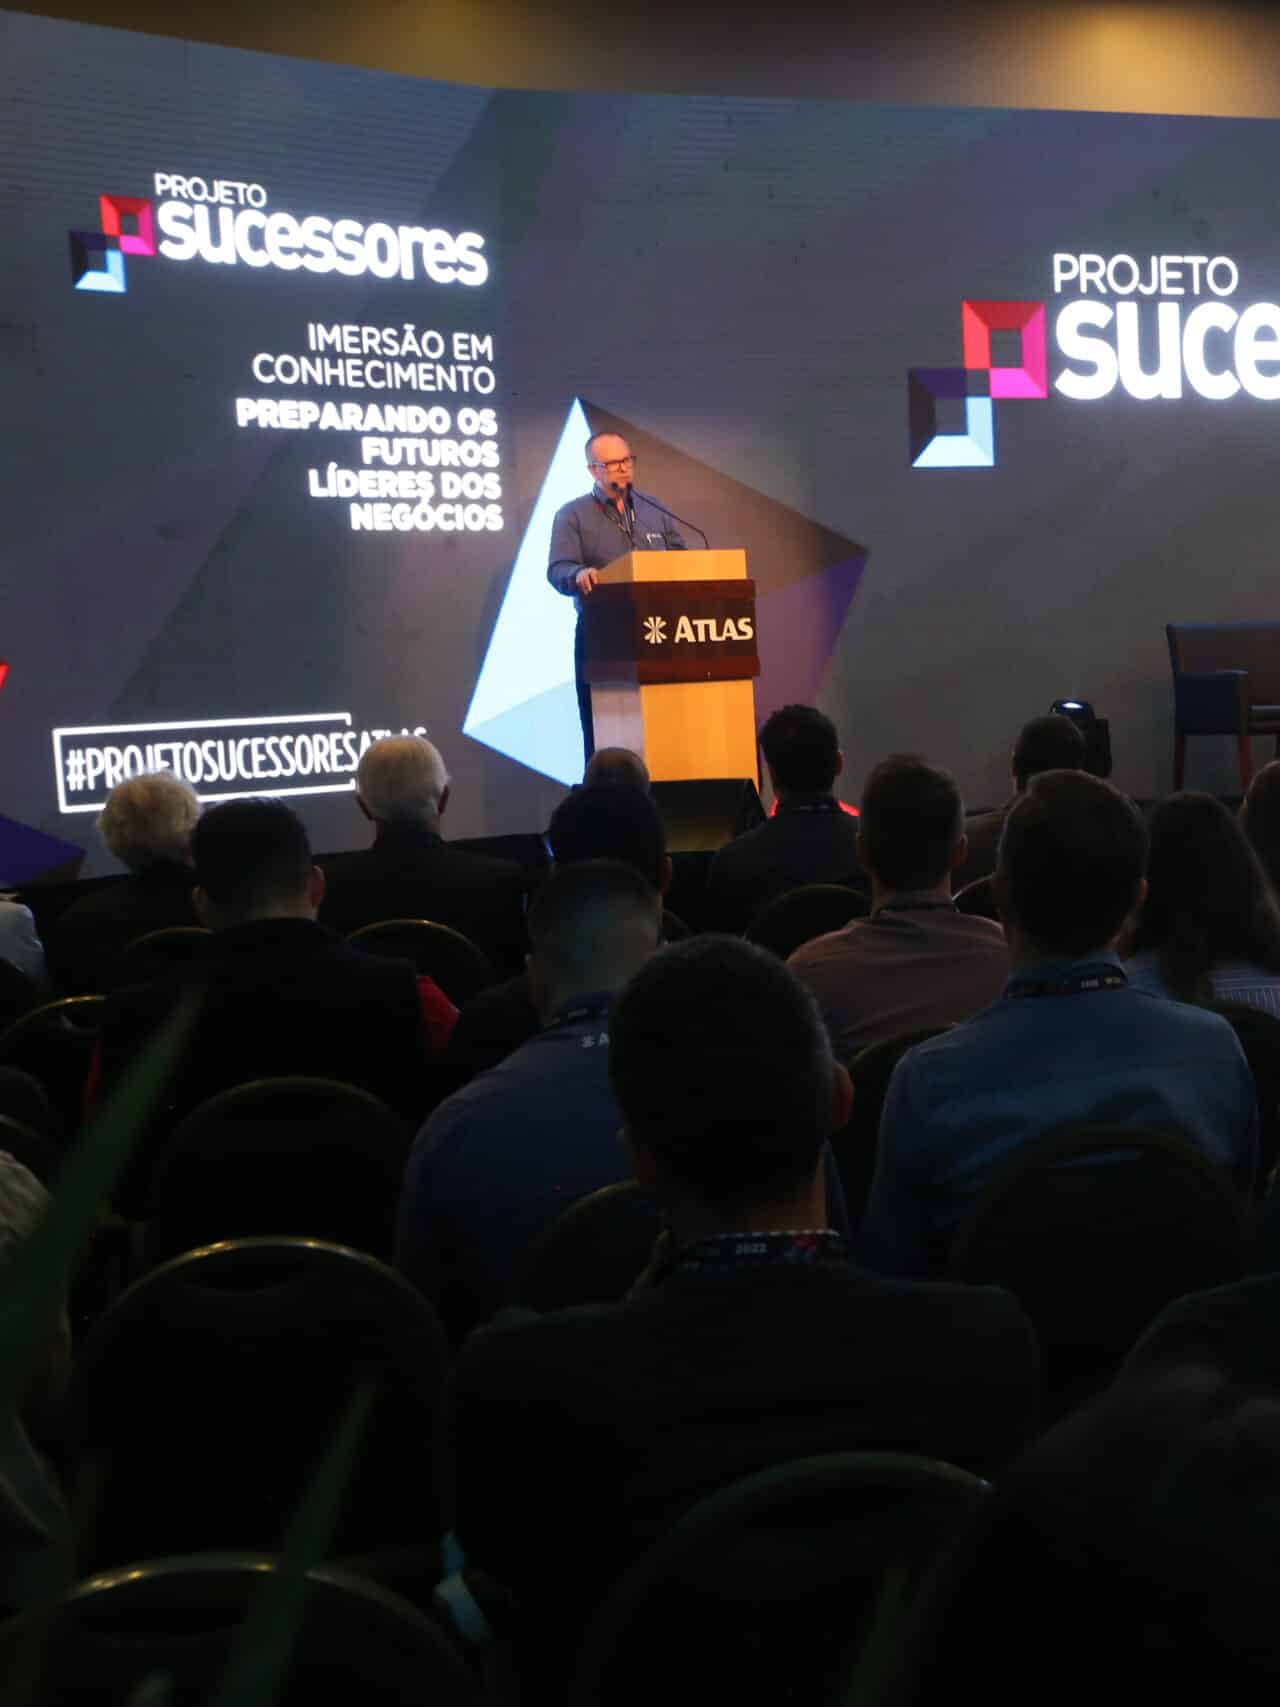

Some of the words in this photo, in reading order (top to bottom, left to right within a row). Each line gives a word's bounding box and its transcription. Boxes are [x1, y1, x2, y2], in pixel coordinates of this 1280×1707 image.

[154, 172, 268, 208] PROJETO
[157, 200, 489, 286] sucessores
[1053, 252, 1240, 296] PROJETO
[307, 322, 446, 359] IMERSÃO
[452, 332, 494, 362] EM
[252, 352, 496, 394] CONHECIMENTO
[235, 397, 452, 434] PREPARANDO
[456, 407, 499, 437] OS
[360, 436, 501, 468] FUTUROS
[308, 461, 436, 499] LÍDERES
[439, 470, 503, 500] DOS
[349, 498, 505, 532] NEGÓCIOS
[674, 615, 754, 644] ATLAS
